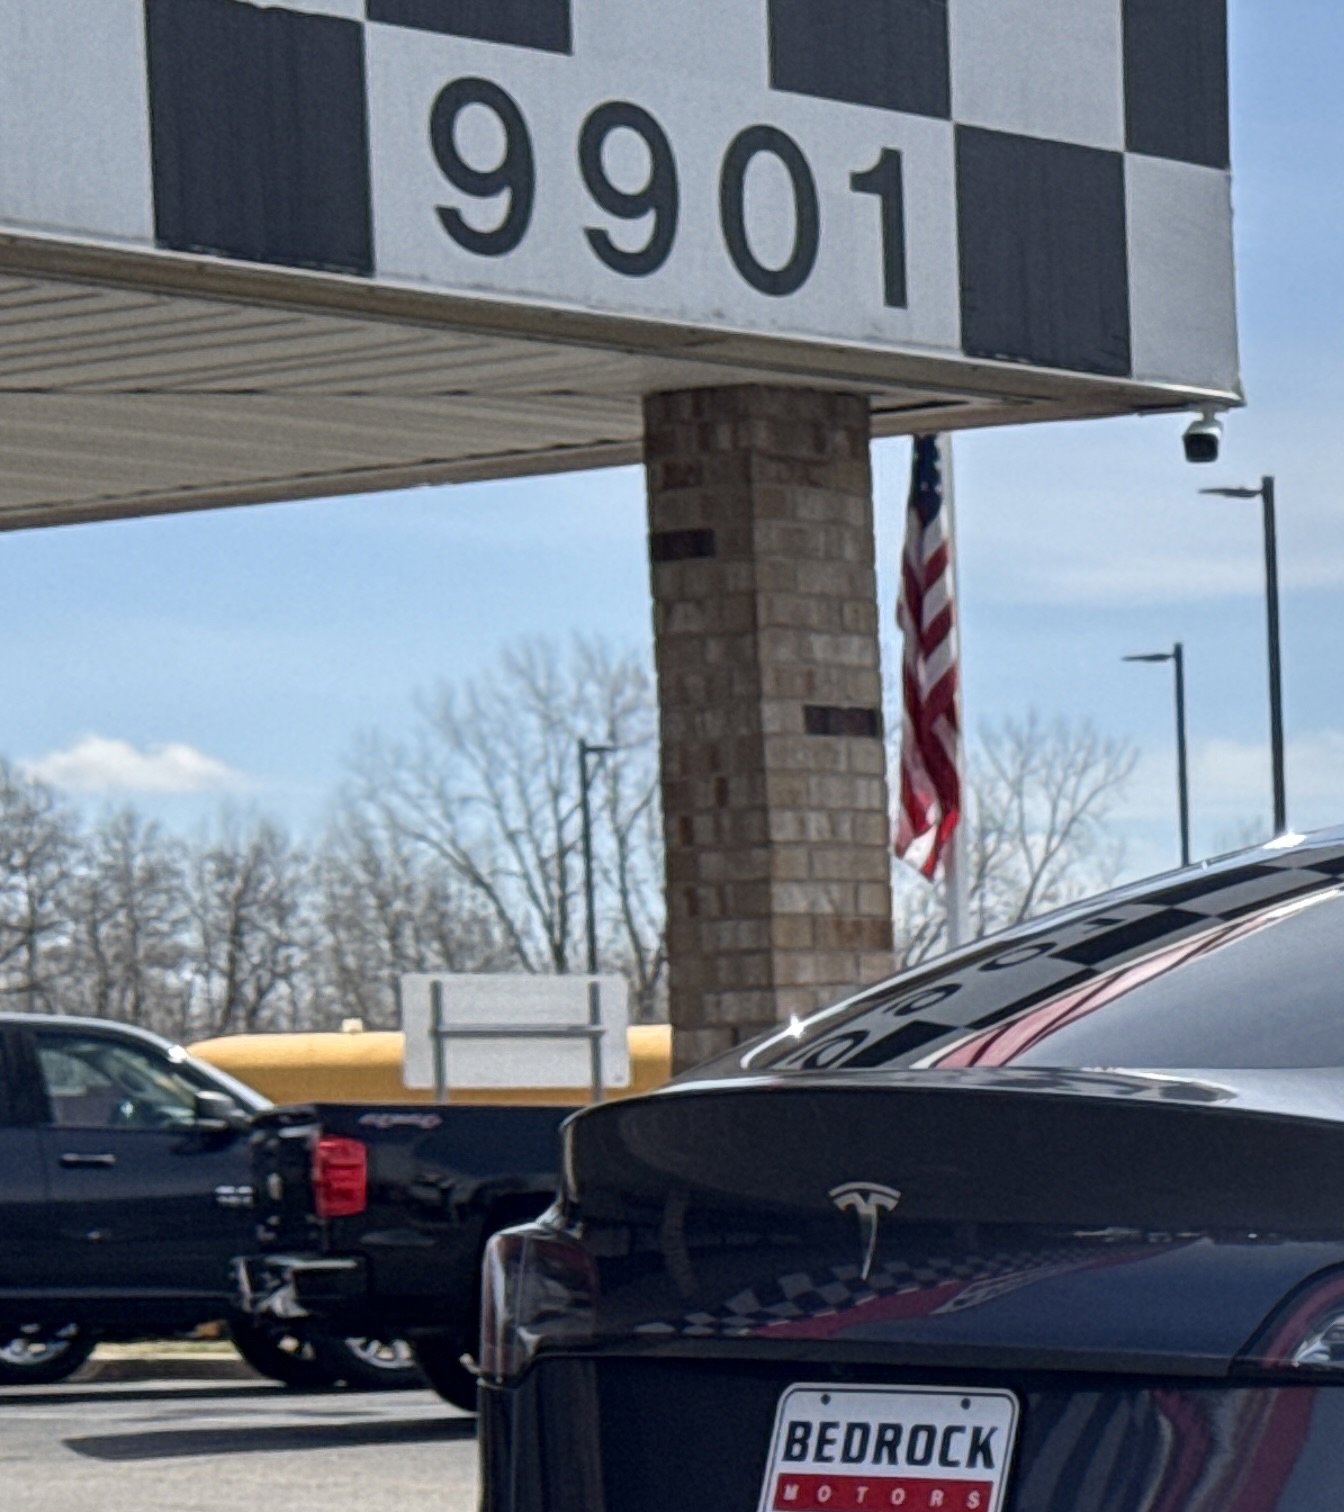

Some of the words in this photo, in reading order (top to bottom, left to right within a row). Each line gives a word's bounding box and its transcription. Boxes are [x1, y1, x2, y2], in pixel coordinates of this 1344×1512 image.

[427, 75, 910, 311] 9901
[781, 1420, 999, 1470] BEDROCK
[783, 1483, 981, 1510] MOTORS
